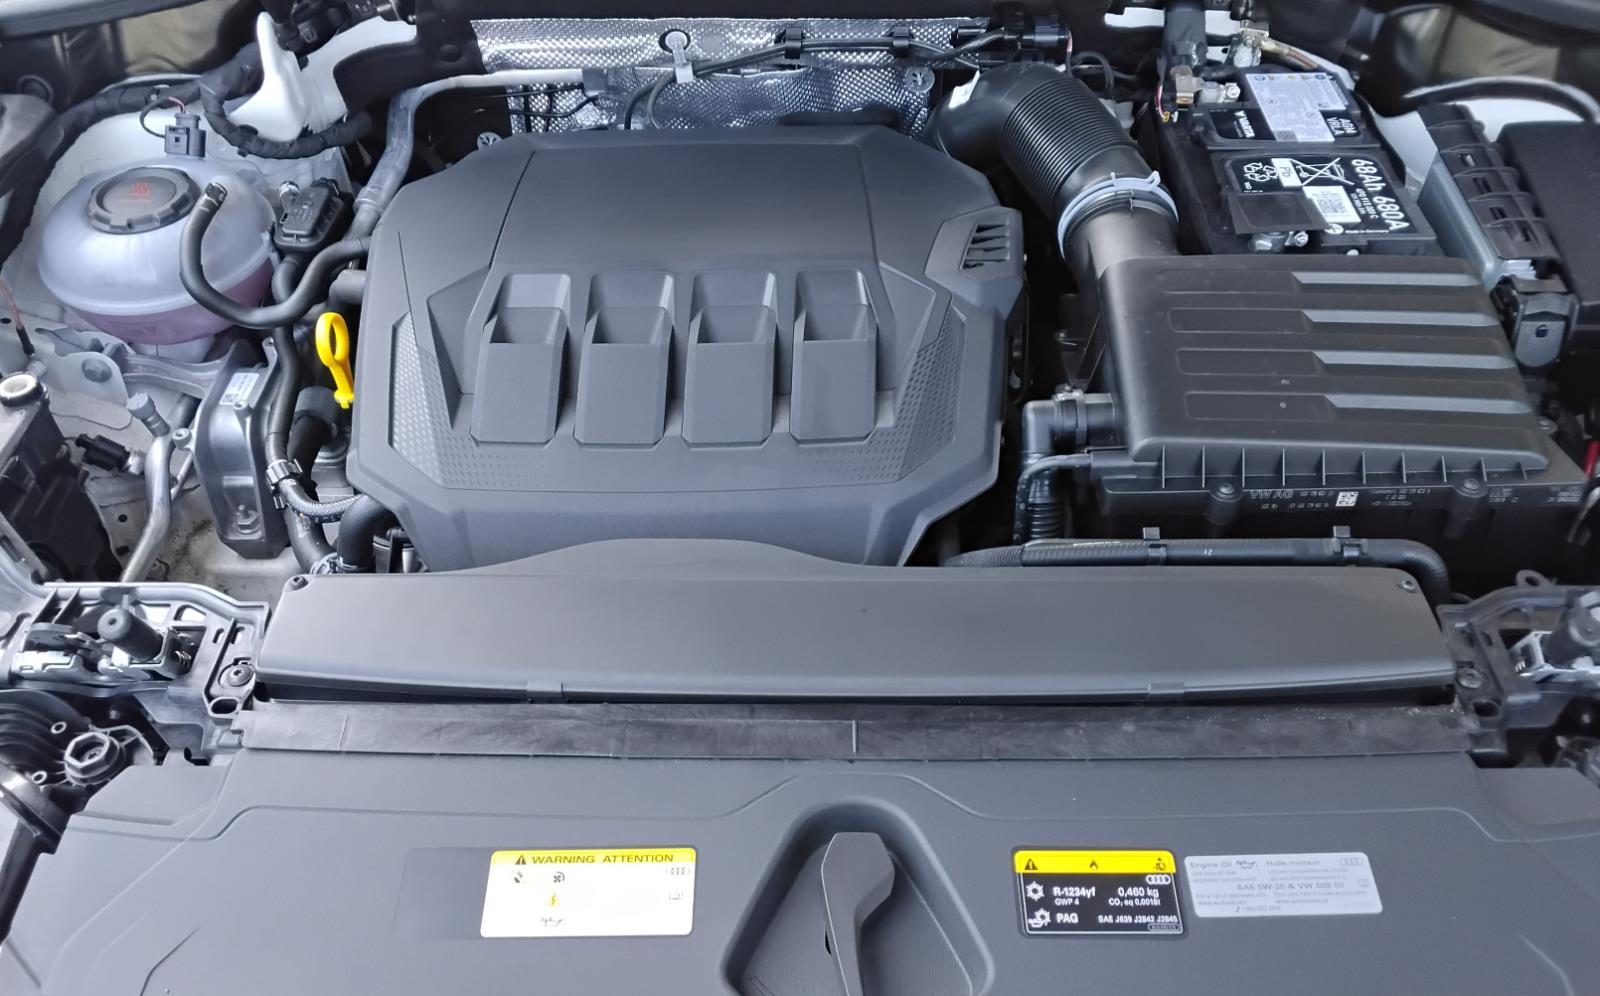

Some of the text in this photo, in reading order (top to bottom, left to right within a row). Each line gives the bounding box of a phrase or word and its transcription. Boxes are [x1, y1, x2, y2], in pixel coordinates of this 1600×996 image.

[1238, 116, 1256, 138] VARTA
[1327, 116, 1345, 136] VRLA
[1339, 118, 1358, 134] AGM
[1351, 159, 1386, 191] 68Ah
[1372, 195, 1410, 231] 680A
[1250, 489, 1272, 499] VW
[532, 854, 674, 864] WARNING ATTENTION
[1190, 861, 1218, 869] Engine
[1297, 881, 1313, 889] VW
[1052, 886, 1096, 899] R-1234yf
[1147, 886, 1159, 899] kg
[1056, 912, 1079, 924] PAG
